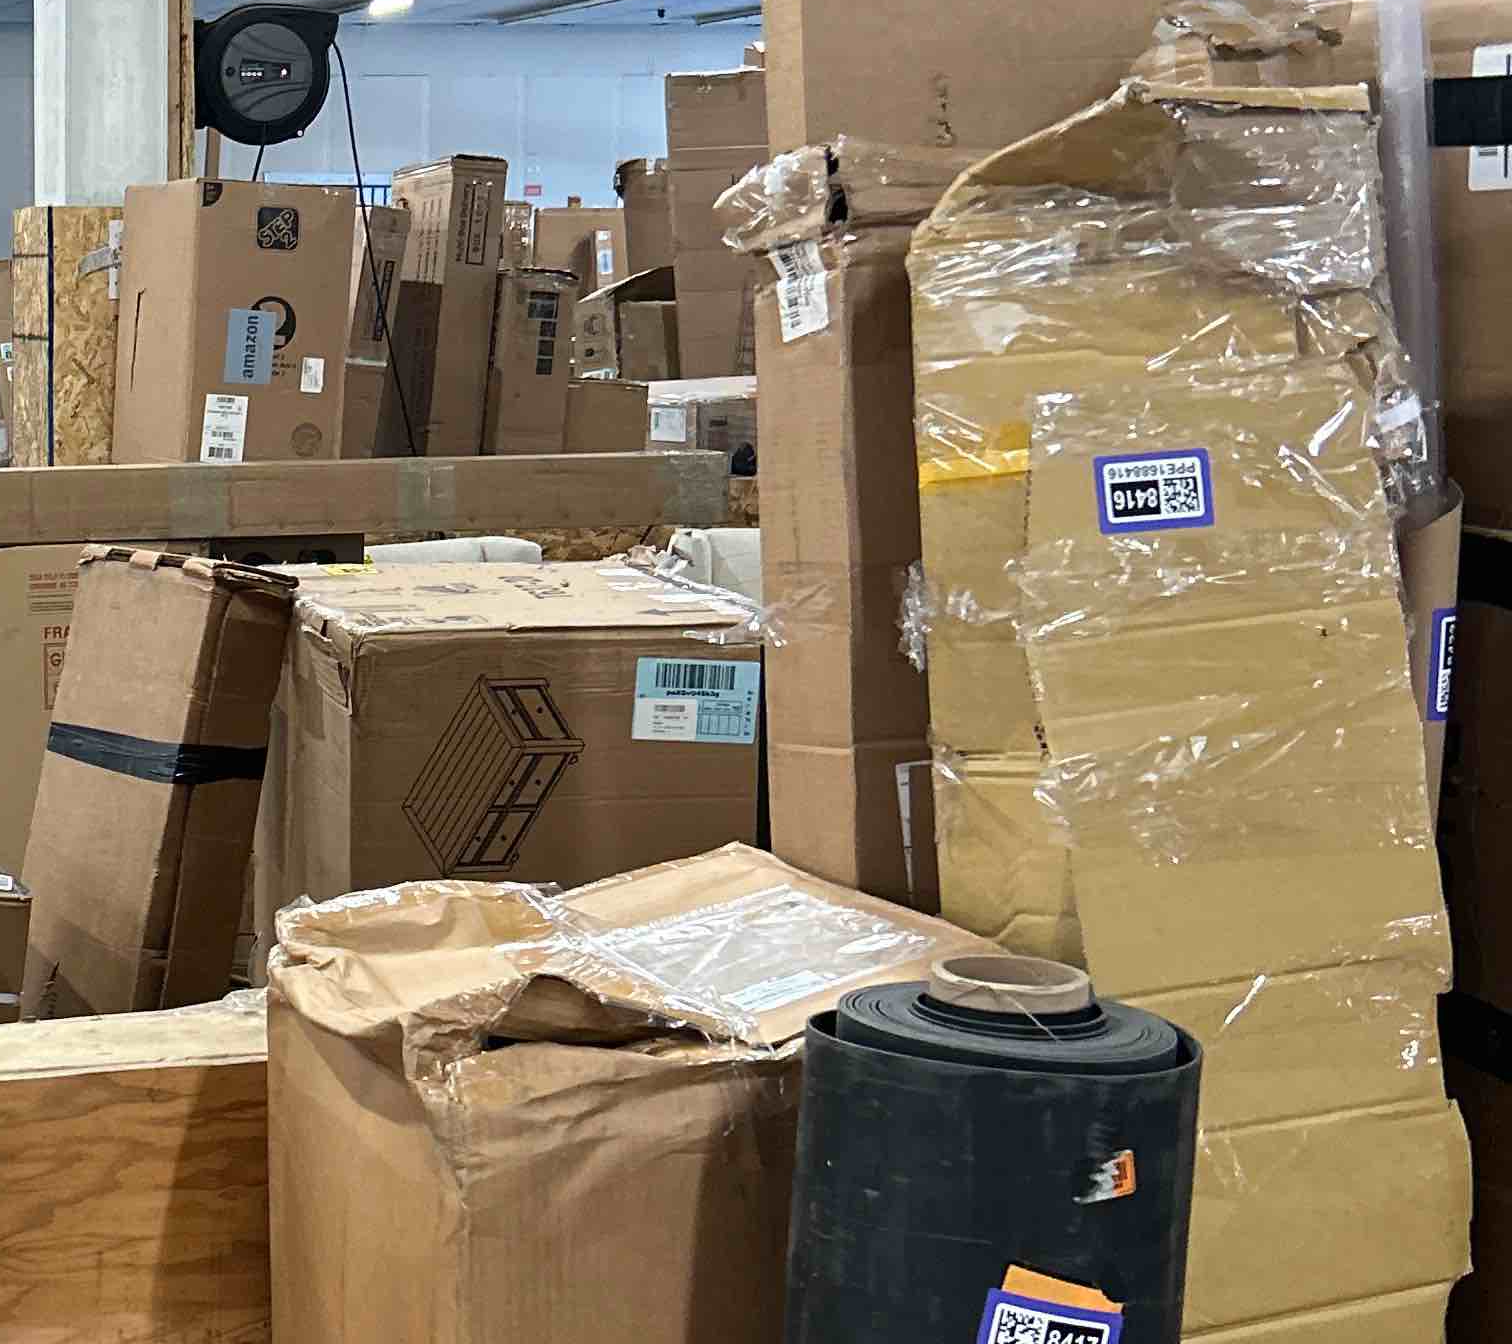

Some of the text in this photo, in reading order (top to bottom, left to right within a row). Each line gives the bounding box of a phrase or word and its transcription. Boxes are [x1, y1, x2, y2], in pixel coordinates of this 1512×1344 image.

[242, 315, 259, 379] amazon
[1108, 461, 1196, 480] PPE1688416
[1113, 487, 1158, 511] 8416
